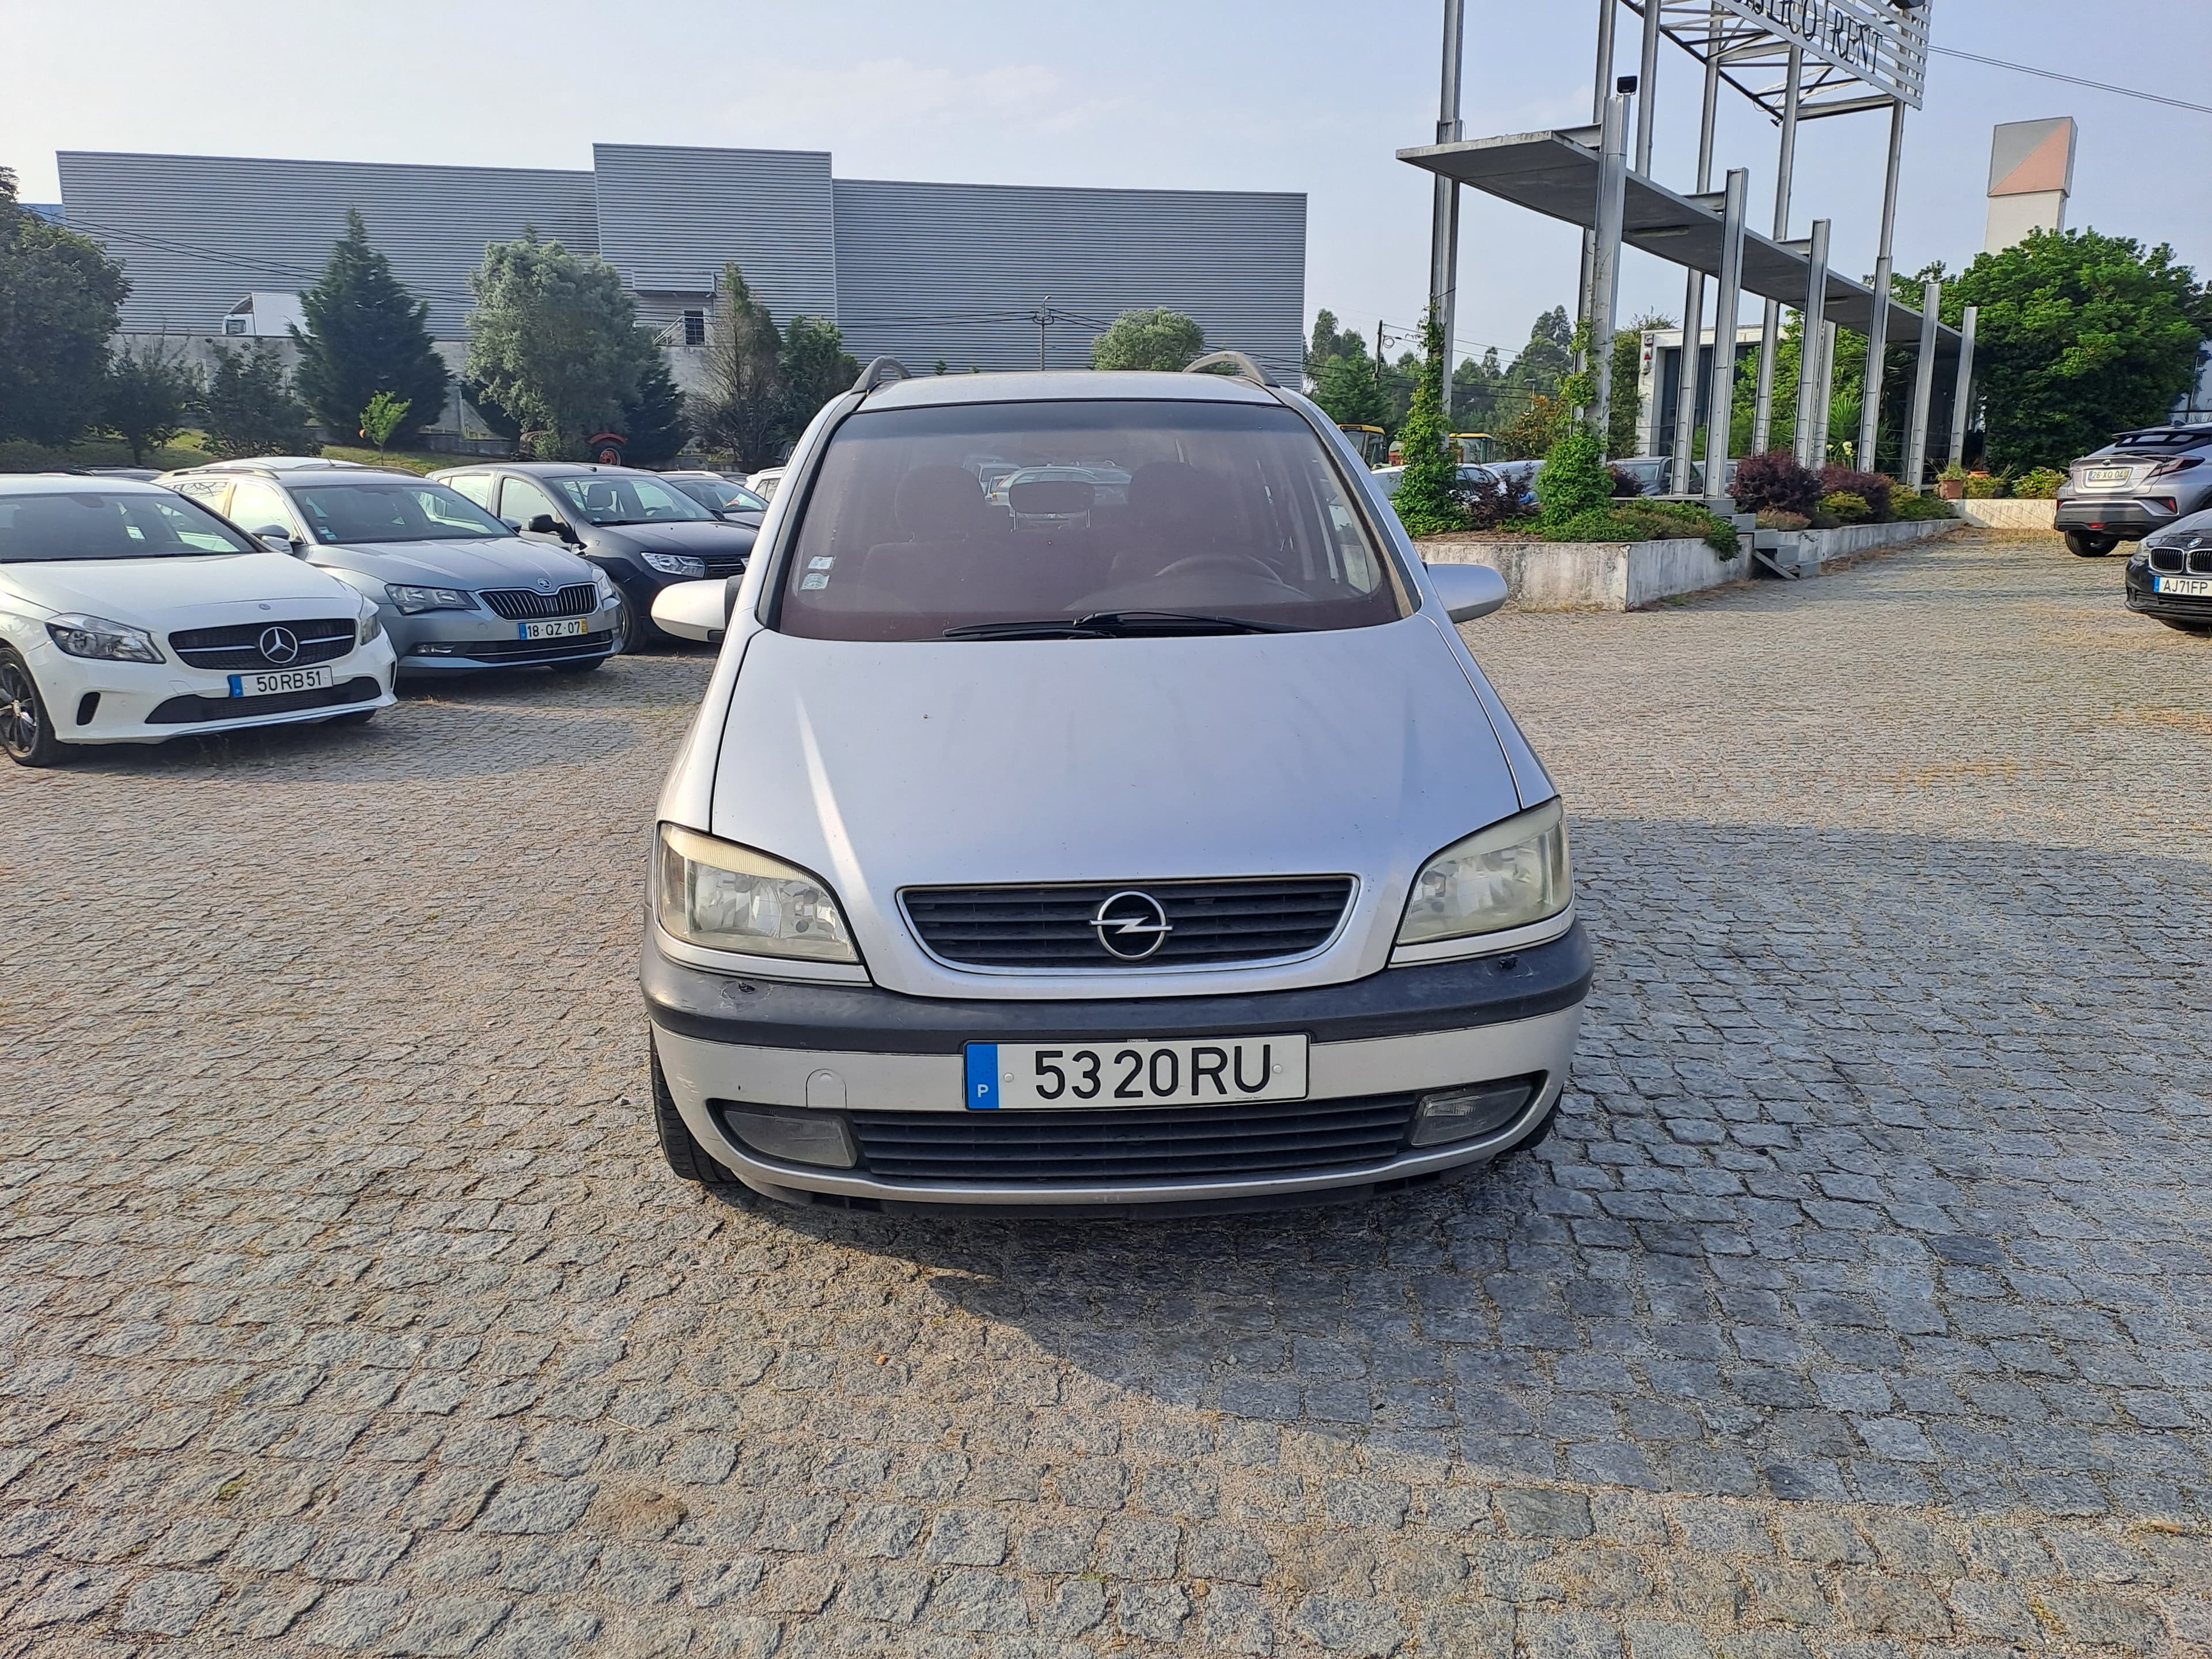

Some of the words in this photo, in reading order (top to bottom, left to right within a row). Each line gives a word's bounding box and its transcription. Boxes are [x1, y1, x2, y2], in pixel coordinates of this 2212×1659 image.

[1831, 8, 1883, 74] RENT
[2163, 579, 2208, 594] AJ71FP
[256, 671, 321, 692] 50RB51
[978, 1084, 989, 1098] P
[1035, 1044, 1271, 1100] 5320RU
